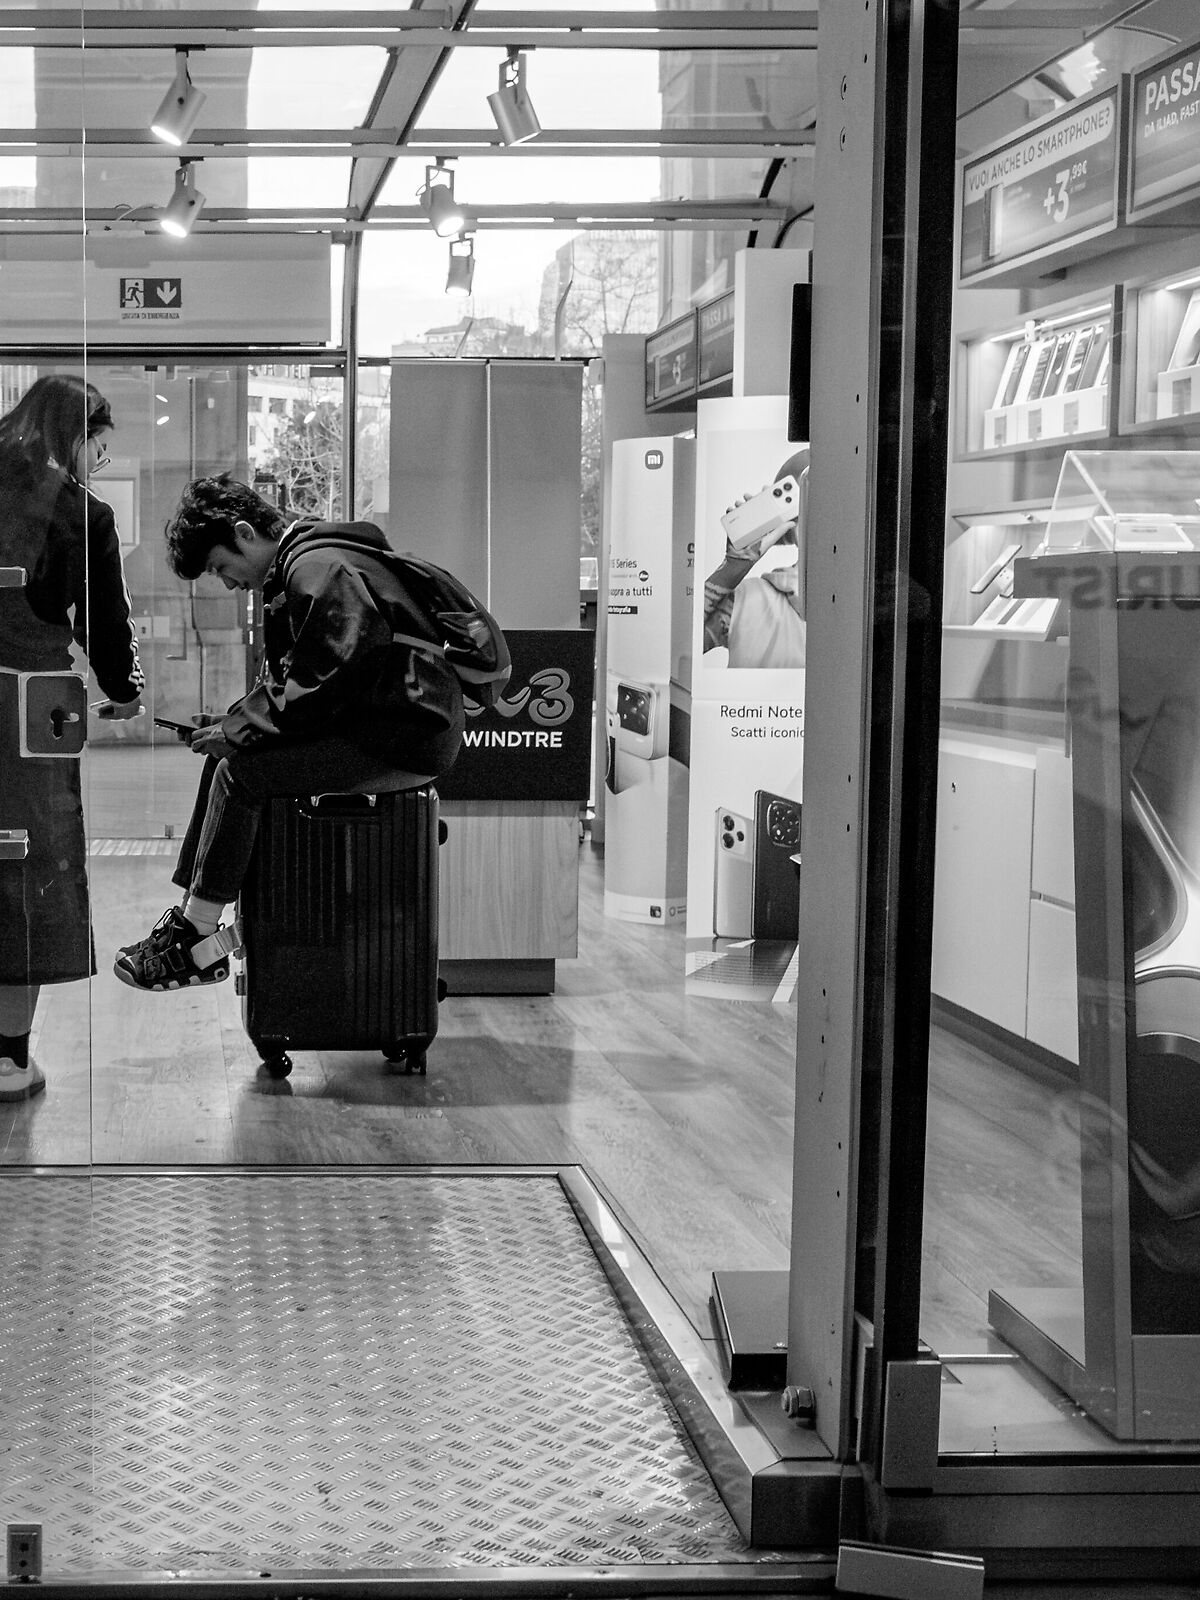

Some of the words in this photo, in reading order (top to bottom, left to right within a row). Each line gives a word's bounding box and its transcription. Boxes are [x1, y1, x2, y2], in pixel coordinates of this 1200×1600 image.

[968, 173, 990, 192] VUOI
[991, 152, 1021, 180] ANCHE
[1023, 146, 1035, 166] LO
[1037, 106, 1111, 159] SMARTPHONE?
[632, 586, 653, 597] tutti
[720, 704, 762, 718] Redmi
[768, 705, 803, 719] Note
[462, 730, 563, 748] WINDTRE
[731, 726, 766, 738] Scatti
